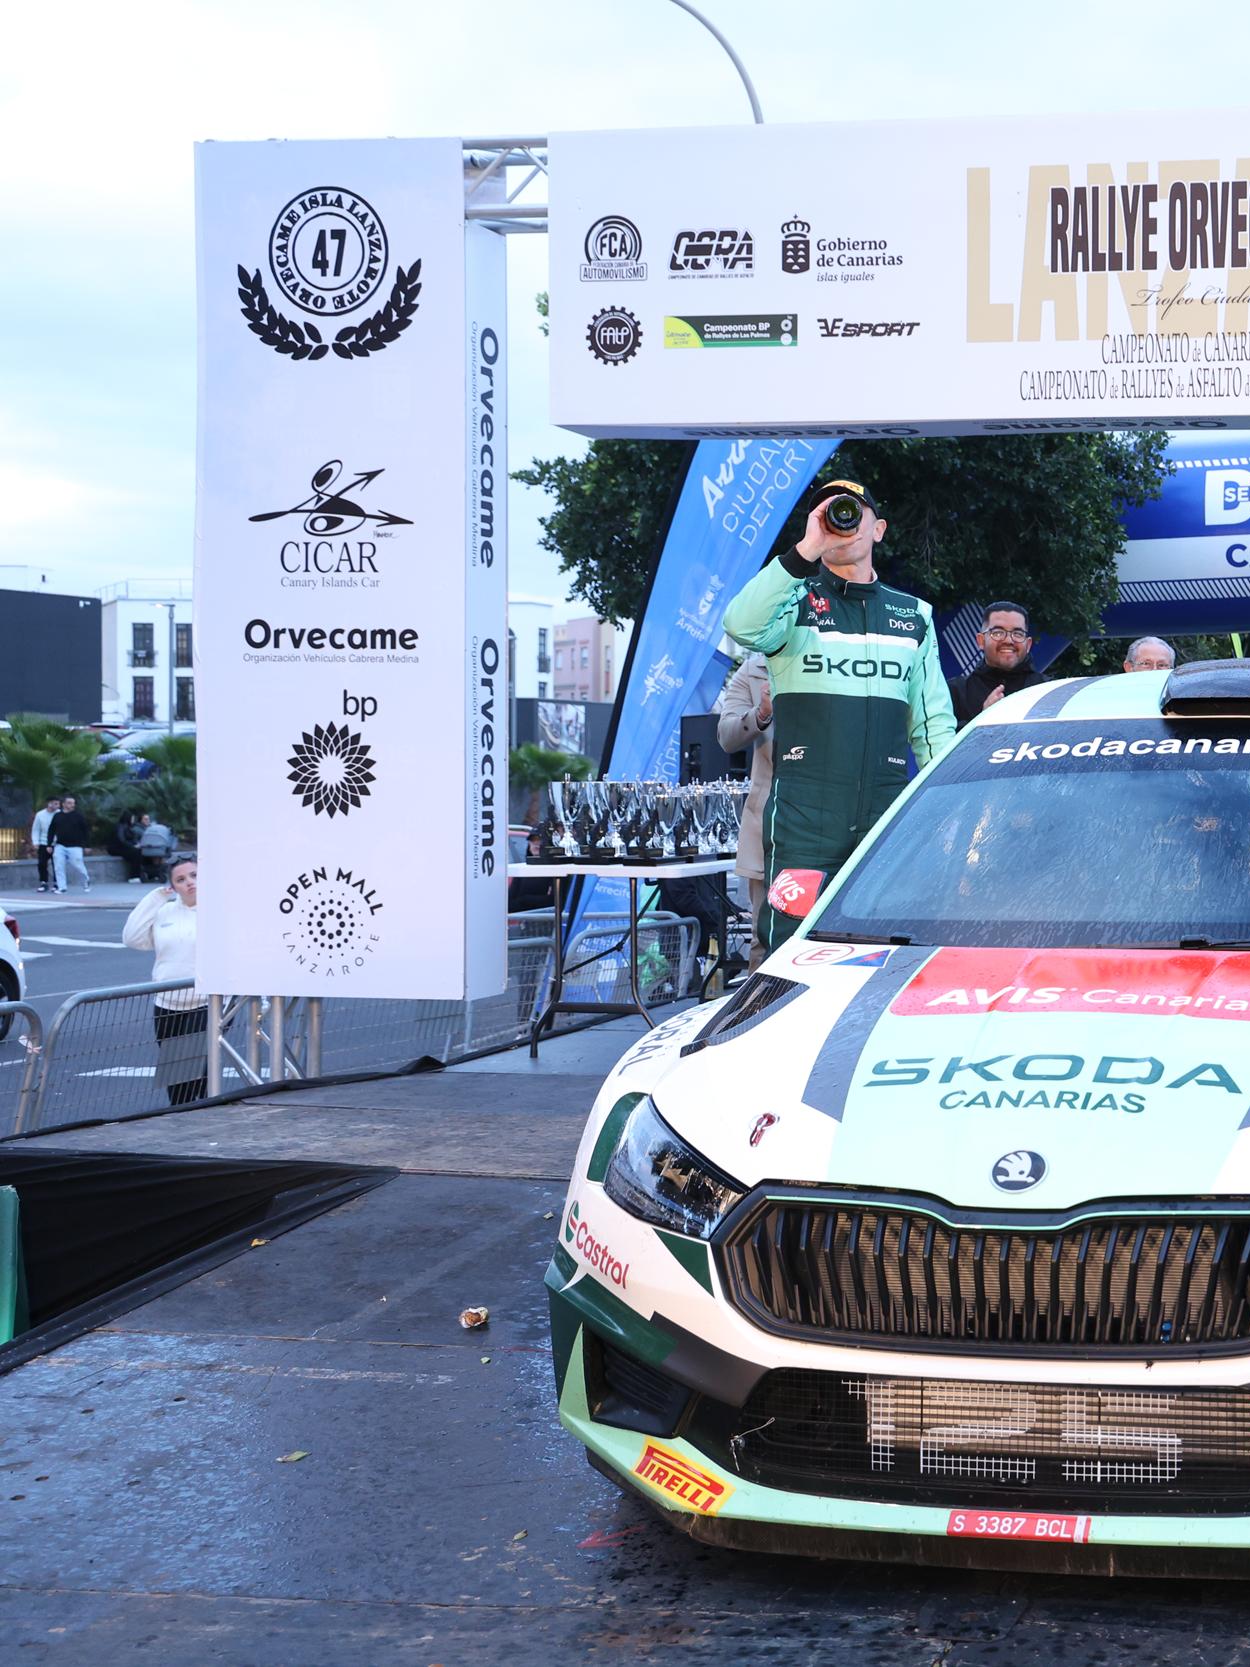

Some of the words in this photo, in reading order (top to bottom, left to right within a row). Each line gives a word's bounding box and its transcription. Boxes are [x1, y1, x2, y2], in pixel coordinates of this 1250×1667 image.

[299, 193, 345, 214] ISLA
[1051, 184, 1158, 273] RALLYE
[275, 209, 327, 309] ORVECAME
[312, 229, 346, 277] 47
[332, 200, 382, 310] LANZAROTE
[600, 232, 628, 257] FCA
[817, 238, 888, 252] Gobierno
[817, 253, 834, 267] de
[837, 252, 903, 267] Canarias
[583, 266, 644, 280] AUTOMOVILISMO
[817, 273, 837, 282] islas
[841, 271, 875, 285] iguales
[1131, 287, 1194, 320] Trofeo
[704, 323, 756, 334] Campeonato
[758, 322, 770, 331] BP
[1101, 333, 1190, 364] CAMPEONATO
[1192, 342, 1201, 363] de
[1019, 370, 1107, 400] CAMPEONATO
[1110, 378, 1118, 399] de
[1122, 368, 1173, 398] RALLYES
[1176, 376, 1185, 397] de
[1188, 367, 1242, 397] ASFALTO
[480, 327, 499, 569] Orvecame
[280, 541, 379, 573] CICAR
[280, 577, 318, 590] Canary
[321, 577, 358, 588] Islands
[361, 577, 380, 588] Car
[244, 618, 419, 650] Orvecame
[889, 619, 915, 631] DAG
[243, 652, 301, 665] Organización
[303, 653, 346, 663] Vehículos
[349, 653, 385, 664] Cabrera
[387, 654, 419, 664] Medina
[343, 689, 378, 722] bp
[481, 638, 499, 877] Orvecame
[279, 867, 328, 914] OPEN
[336, 868, 384, 916] MALL
[282, 931, 380, 977] LANZAROTE
[805, 949, 841, 961] E
[926, 987, 1067, 1007] AVIS
[938, 1090, 1147, 1114] CANARIAS
[575, 1221, 630, 1289] Castrol
[635, 1444, 726, 1512] PIRELLI
[952, 1516, 966, 1533] S
[974, 1516, 1027, 1535] 3387
[1035, 1518, 1073, 1539] BCL
